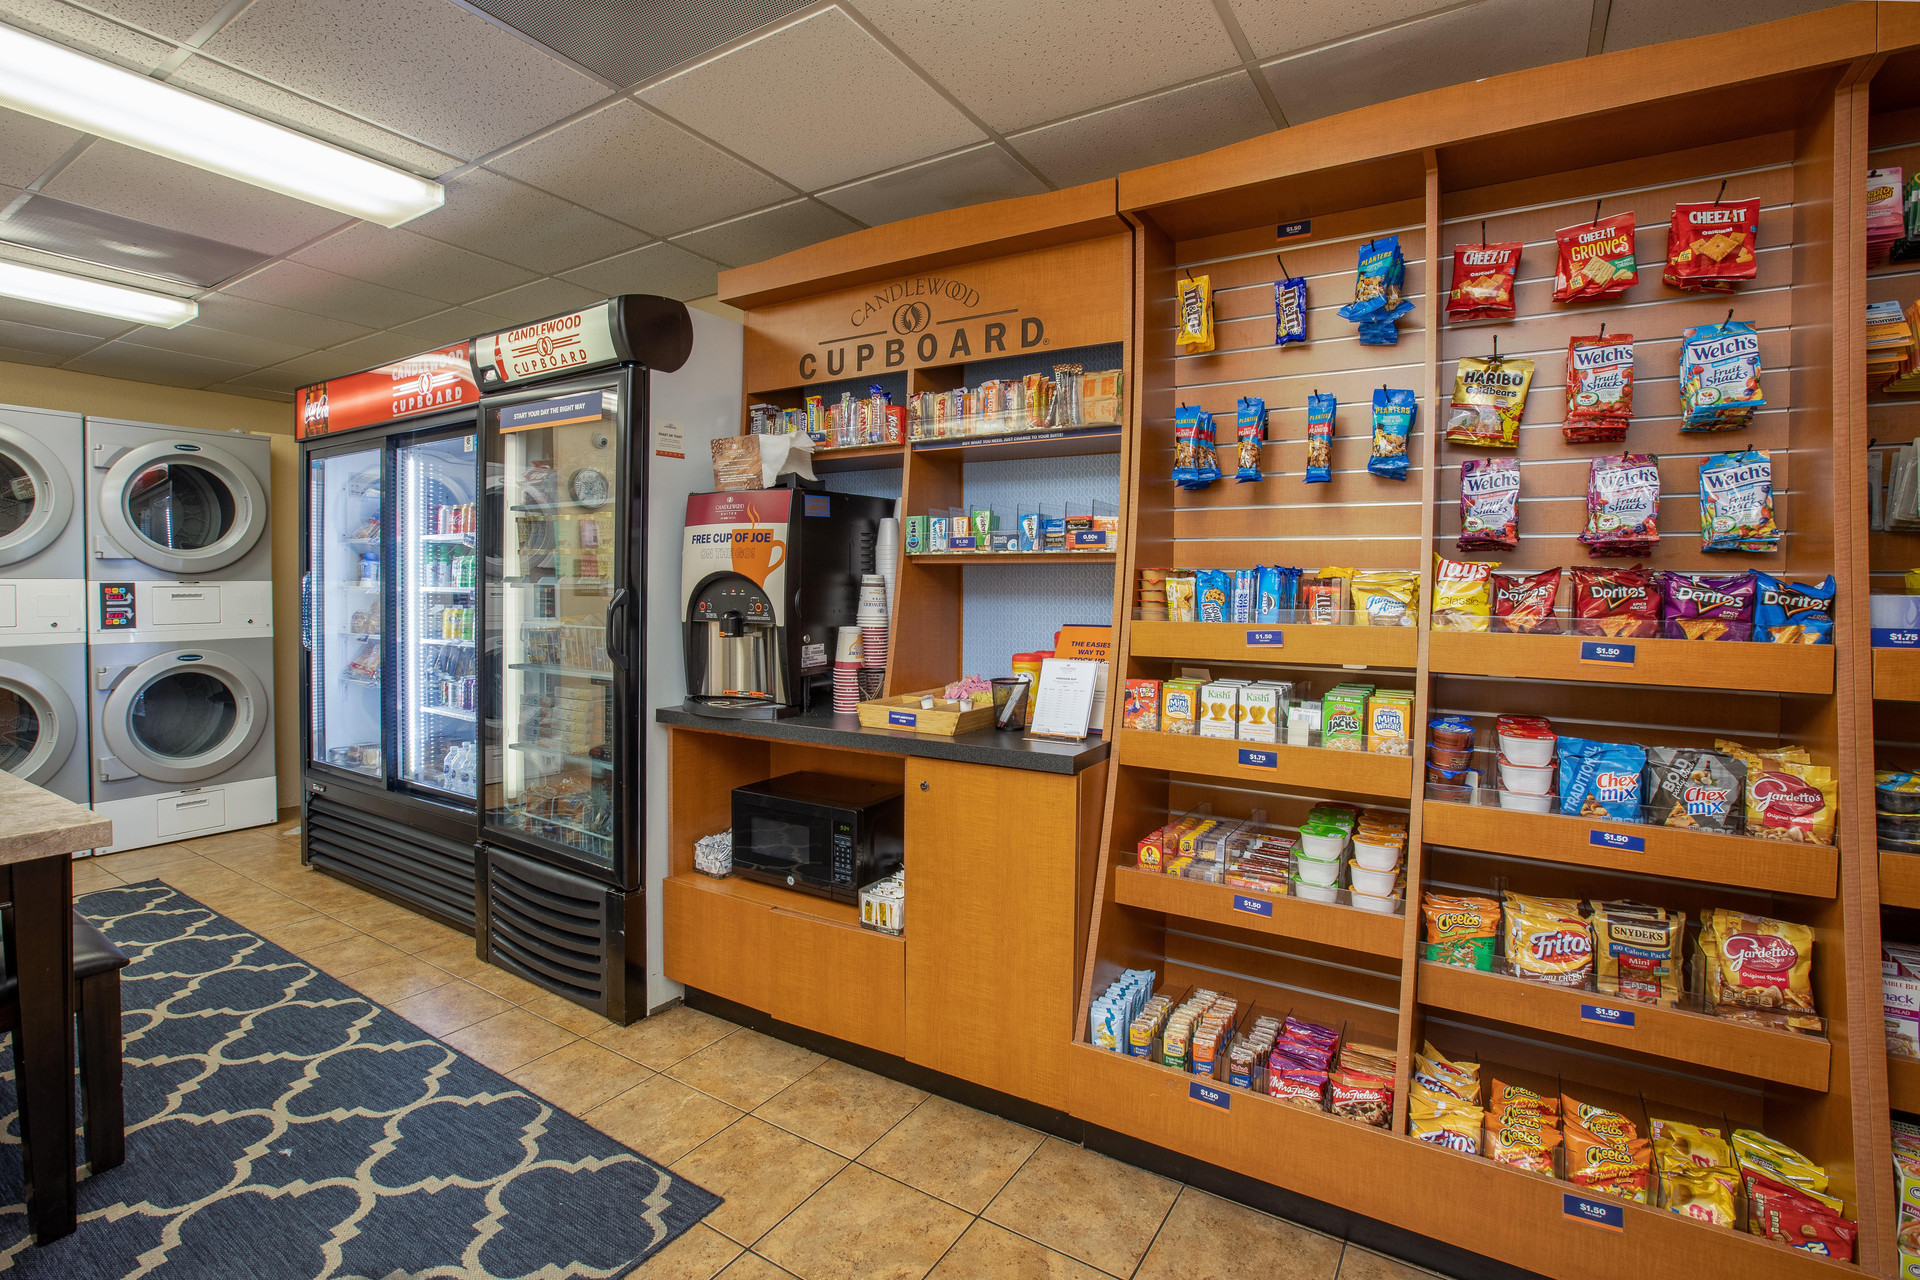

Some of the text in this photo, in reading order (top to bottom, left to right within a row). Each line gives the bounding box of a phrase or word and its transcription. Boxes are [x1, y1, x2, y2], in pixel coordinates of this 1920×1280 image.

[1286, 225, 1302, 233] $1.50
[1361, 250, 1392, 267] PLANTERS
[851, 276, 980, 327] CANDLEWOOD
[508, 314, 581, 343] CANDLEWOOD
[799, 317, 1044, 380] CUPBOARD
[1692, 337, 1757, 361] Welch's
[513, 349, 587, 375] CUPBOARD
[1576, 347, 1633, 366] Welch's
[391, 349, 464, 381] CANDLEWOOD
[1713, 365, 1742, 378] Fruit
[1464, 370, 1524, 387] HARIBO
[1594, 372, 1620, 383] Fruit
[1706, 370, 1748, 387] Snacks
[1466, 385, 1518, 398] Goldbears
[1586, 380, 1624, 391] Snacks
[392, 386, 463, 414] CUPBOARD
[513, 402, 586, 420] START YOUR DAY THE RIGHT WAY
[1375, 405, 1410, 415] PLANTERS
[1176, 418, 1197, 426] PLANTERS
[1309, 413, 1331, 421] PLANTERS
[1176, 430, 1196, 438] PEANUTS
[1308, 426, 1329, 436] PEANUTS
[1706, 464, 1771, 487] Welch's
[1468, 473, 1519, 492] Welch's
[1479, 497, 1504, 509] Fruit
[1615, 496, 1641, 507] Fruit
[1728, 491, 1756, 505] Fruit
[715, 503, 745, 511] CANDLEWOOD
[1473, 504, 1509, 515] Snacks
[1607, 502, 1648, 513] Snacks
[1025, 516, 1035, 542] Trident
[691, 532, 771, 544] FREE CUP OF JOE
[700, 547, 756, 559] ON THE GO!
[1498, 585, 1547, 602] Doritos
[1591, 584, 1646, 600] Doritos
[1678, 587, 1744, 608] Doritos
[1440, 595, 1479, 607] Classic
[1764, 592, 1833, 611] Doritos
[1889, 632, 1918, 641] $1.75
[1596, 647, 1620, 655] $1.50
[1207, 689, 1231, 700] Kashi
[1246, 692, 1270, 703] Kashi
[1169, 698, 1189, 708] Mini
[1333, 704, 1354, 712] Kellogg's
[1327, 719, 1359, 734] JACKS
[1375, 722, 1402, 732] Wheats
[1377, 716, 1401, 725] Mini
[1249, 753, 1266, 761] $1.75
[1564, 746, 1601, 811] TRADITIONAL
[1597, 772, 1640, 788] Chex
[1662, 758, 1689, 794] BOLD
[1601, 786, 1637, 803] mix
[1684, 787, 1731, 803] Chex
[1751, 777, 1821, 812] Gardetto's
[1688, 800, 1726, 816] mix
[1766, 812, 1789, 821] Original
[1604, 832, 1629, 843] $1.50
[1243, 899, 1262, 909] $1.50
[1437, 912, 1482, 931] Cheetos
[1614, 925, 1664, 942] SNYDER'S
[1531, 929, 1592, 961] Fritos
[1612, 944, 1667, 960] 100 Calorie Pack
[1723, 936, 1795, 972] Gardetto's
[1628, 957, 1650, 966] Mini
[1742, 971, 1766, 980] Original
[1883, 992, 1914, 1005] nack
[1595, 1007, 1620, 1017] $1.50
[1890, 1008, 1911, 1016] SALAD
[1131, 1033, 1149, 1042] Toasty
[1234, 1077, 1248, 1085] Peanut
[1200, 1088, 1219, 1100] $1.50
[1504, 1086, 1540, 1100] Cheetos
[1499, 1128, 1541, 1146] Cheetos
[1586, 1145, 1633, 1166] Cheetos
[1579, 1203, 1606, 1216] $1.50
